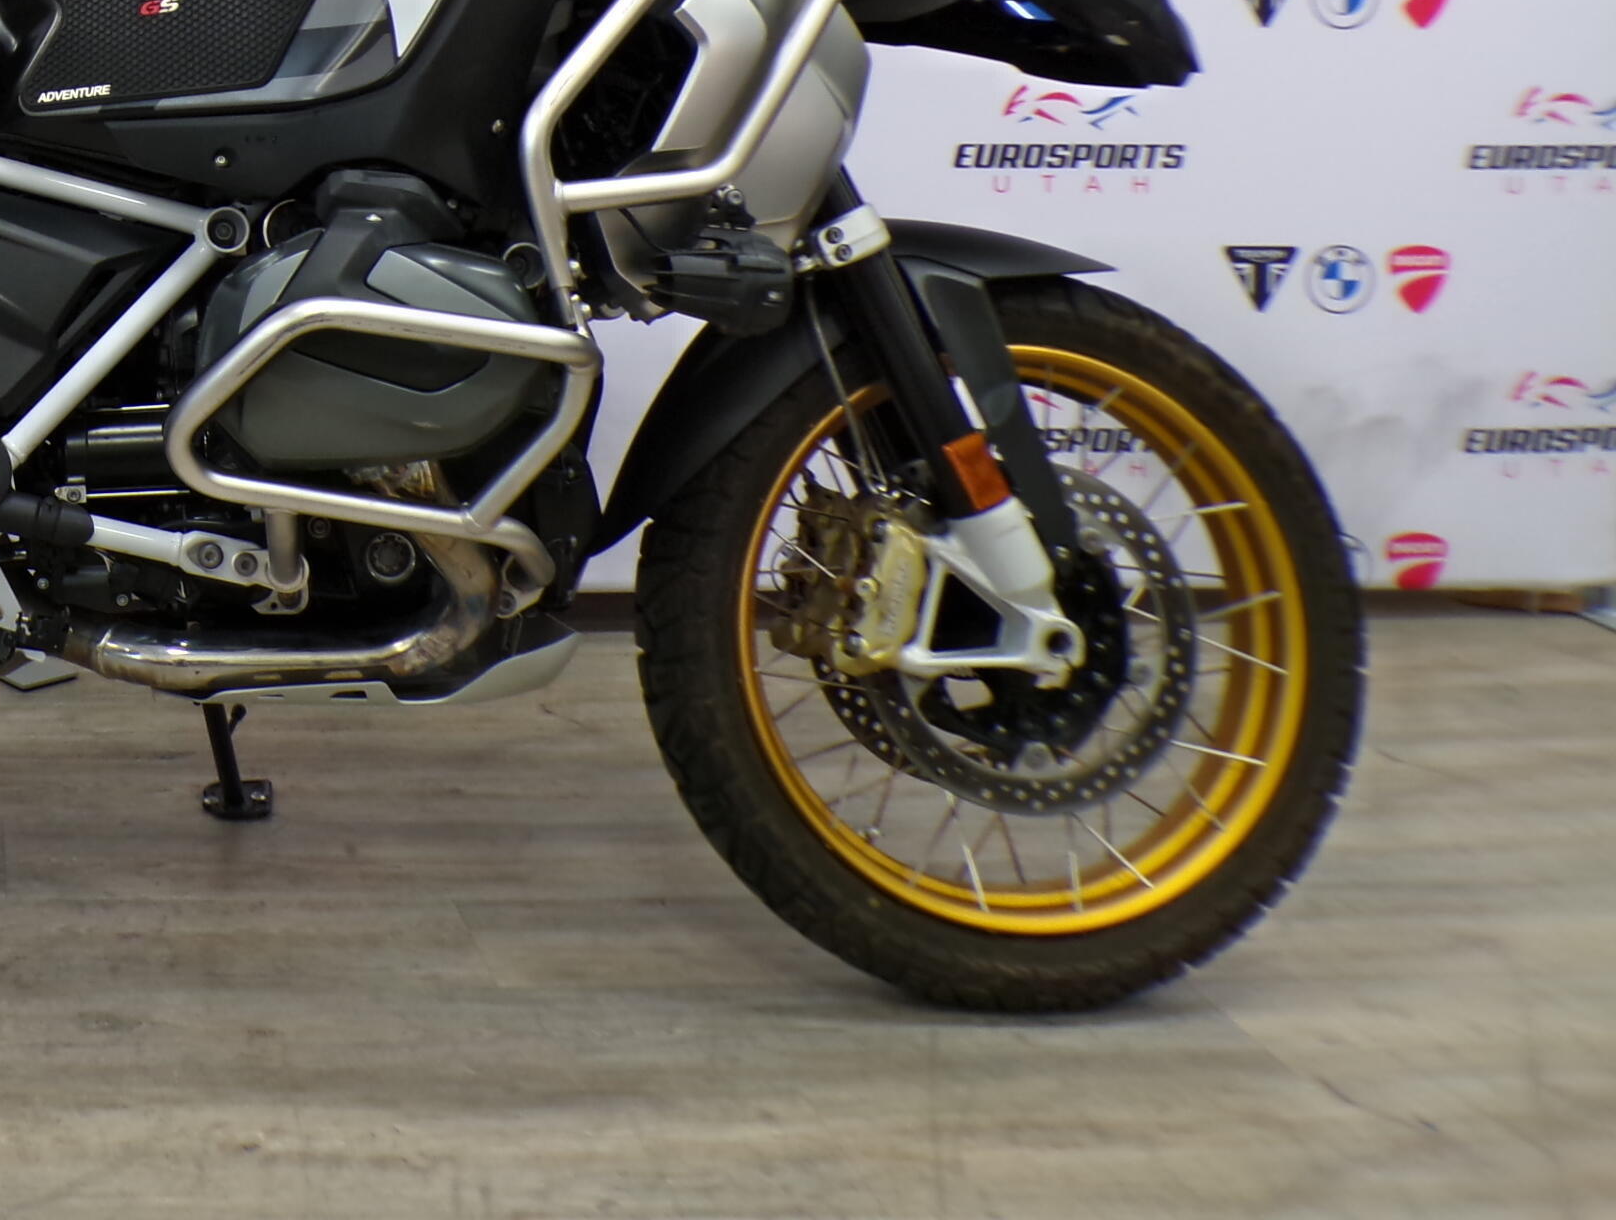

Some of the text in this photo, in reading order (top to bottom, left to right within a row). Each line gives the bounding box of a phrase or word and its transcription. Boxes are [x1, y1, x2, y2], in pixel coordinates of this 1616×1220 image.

[37, 84, 112, 104] ADVENTURE
[954, 143, 1185, 170] EUROSPORTS
[994, 176, 1151, 194] UTAH
